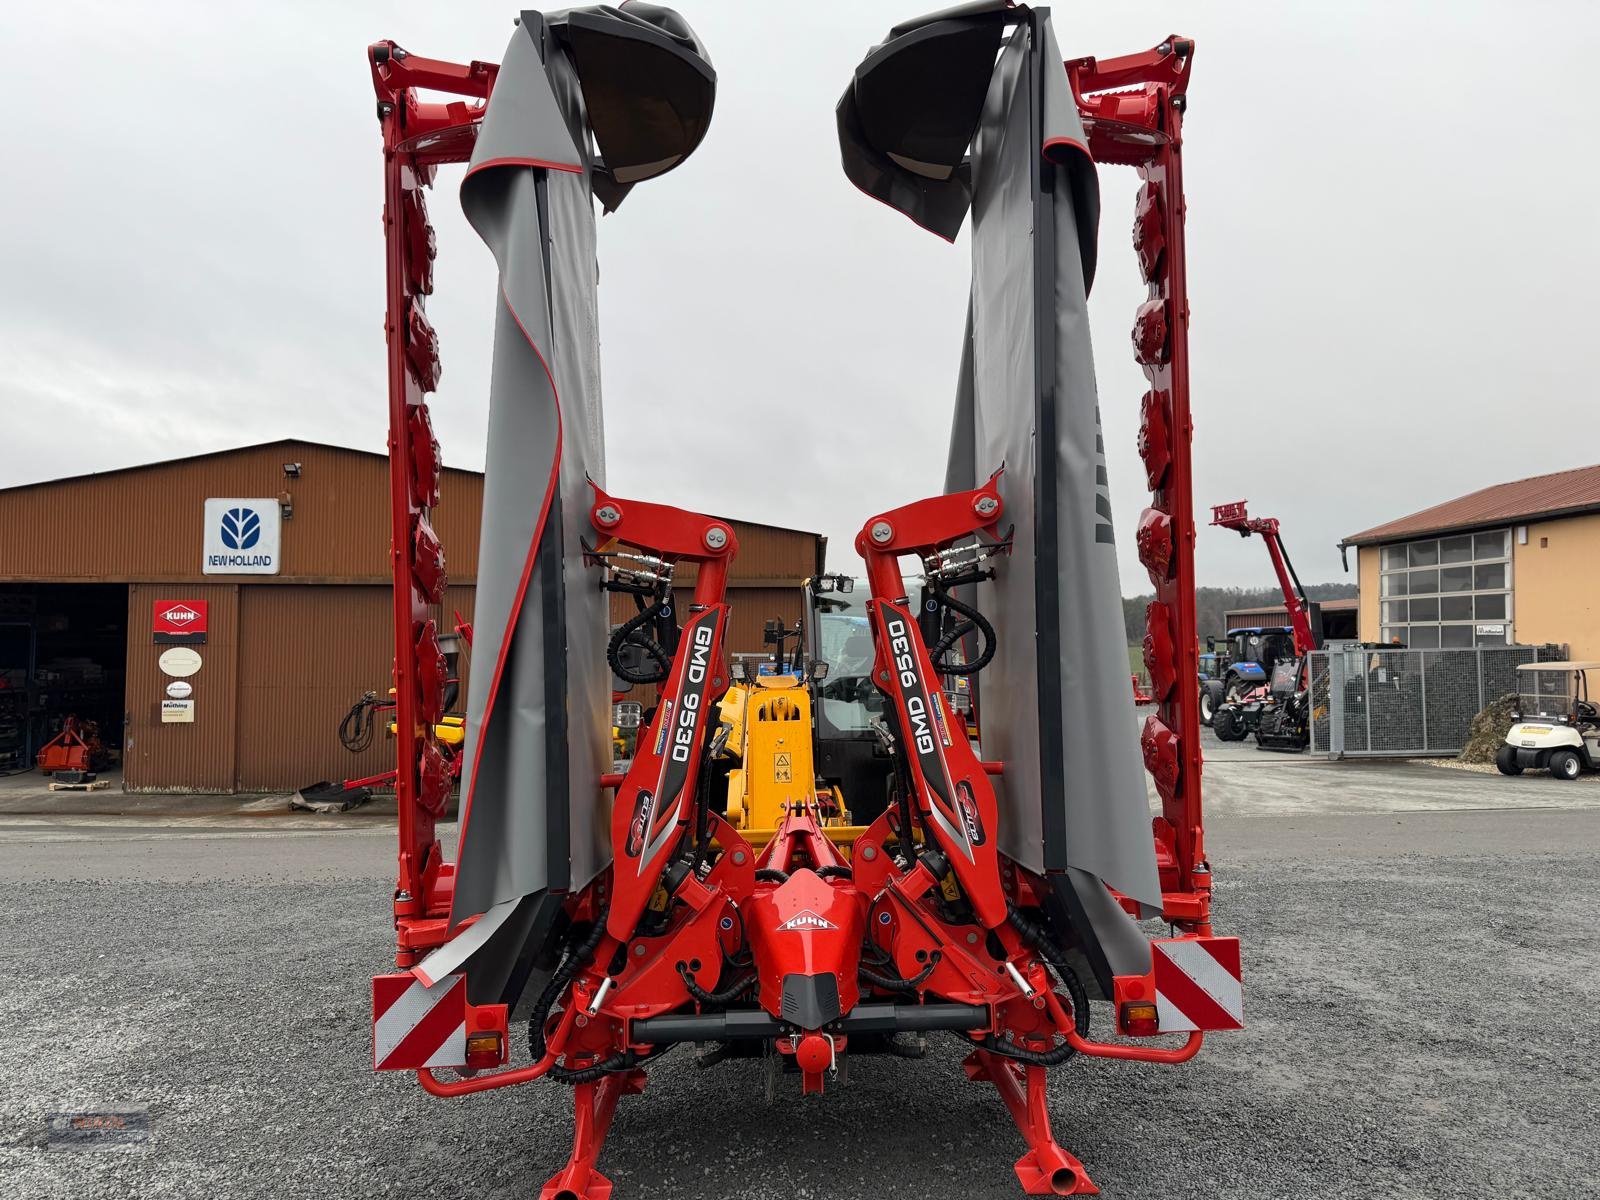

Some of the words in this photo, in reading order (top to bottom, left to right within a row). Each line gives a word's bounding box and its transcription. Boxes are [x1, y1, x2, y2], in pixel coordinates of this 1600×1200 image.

[208, 555, 228, 567] NEW
[229, 555, 272, 567] HOLLAND
[166, 612, 195, 620] KUHN
[688, 626, 712, 683] GMD
[888, 620, 917, 688] 9530
[672, 693, 699, 762] 9530
[908, 697, 935, 754] GMD
[637, 795, 650, 834] ELITE
[963, 803, 979, 841] ELITE
[786, 917, 828, 929] KUHN
